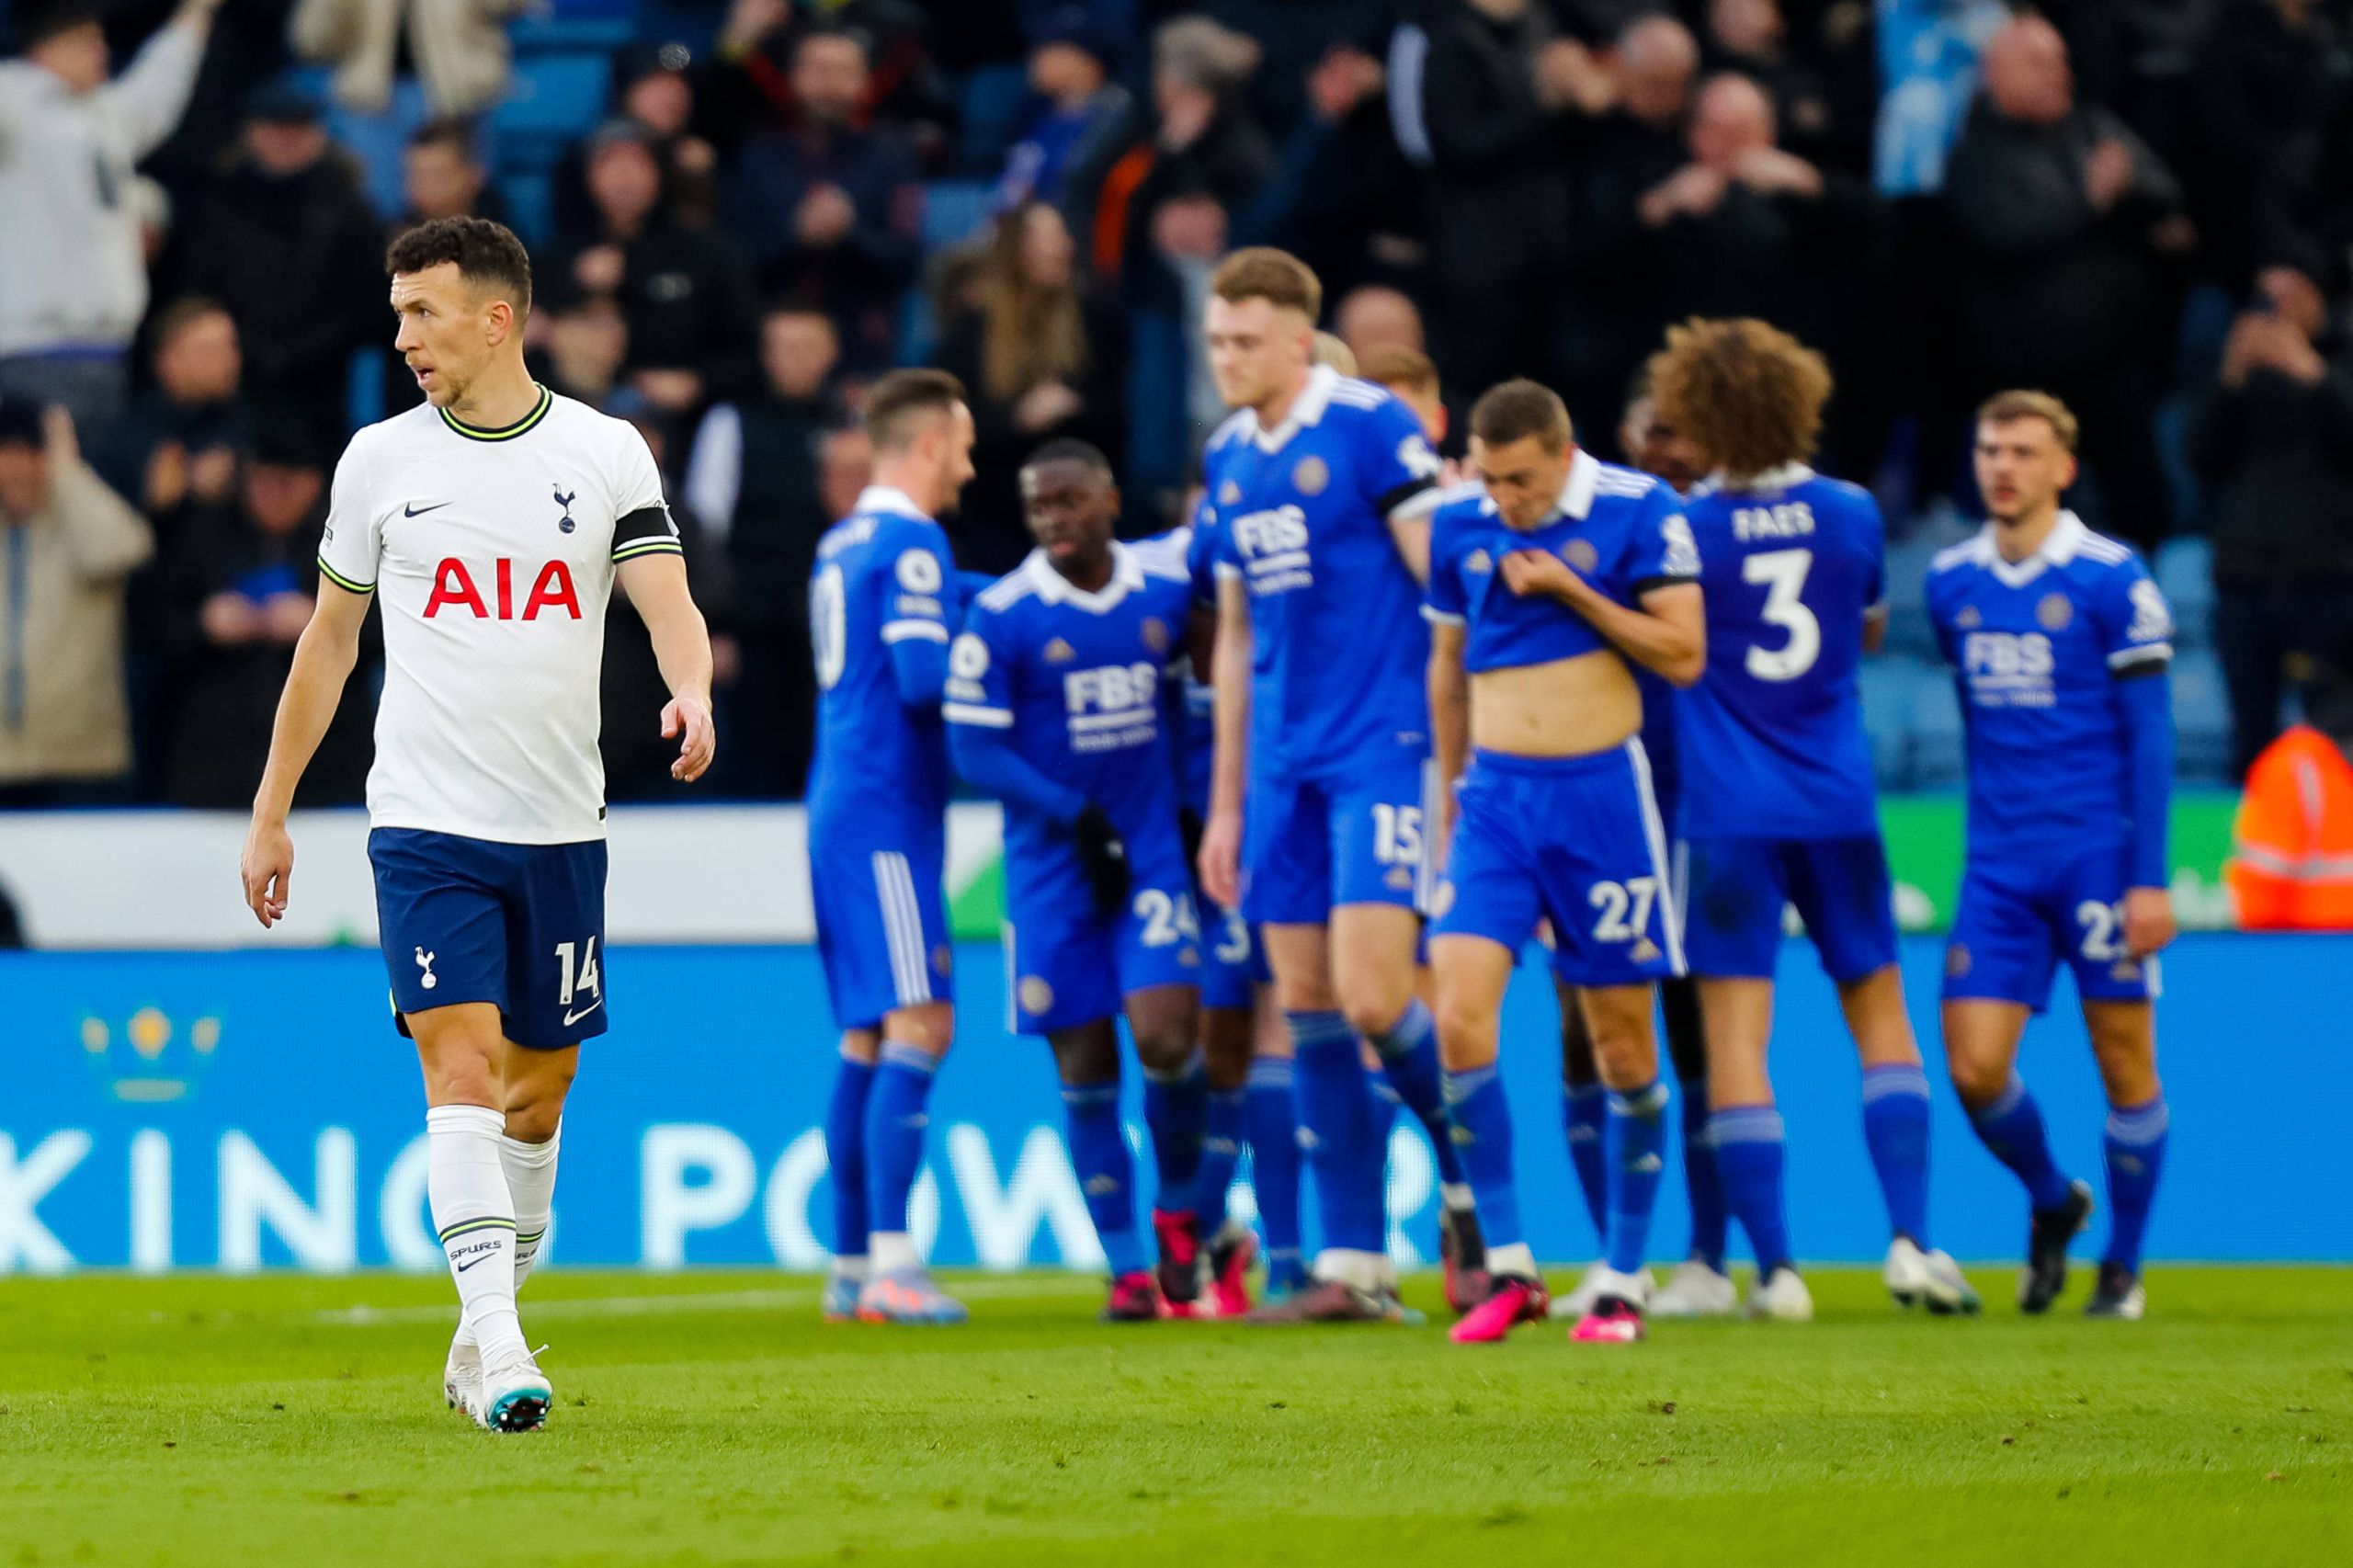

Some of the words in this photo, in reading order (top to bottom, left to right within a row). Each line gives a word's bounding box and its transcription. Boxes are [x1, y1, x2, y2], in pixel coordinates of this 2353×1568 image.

[1233, 504, 1309, 559] FBS
[1730, 501, 1816, 542] FAES
[422, 556, 583, 621] AIA
[1743, 549, 1822, 683] 3
[1964, 631, 2055, 676] FBS
[1063, 661, 1158, 714] FBS
[1371, 802, 1423, 865] 15
[1589, 876, 1658, 943] 27
[555, 935, 599, 1005] 14
[449, 1240, 502, 1261] SPURS
